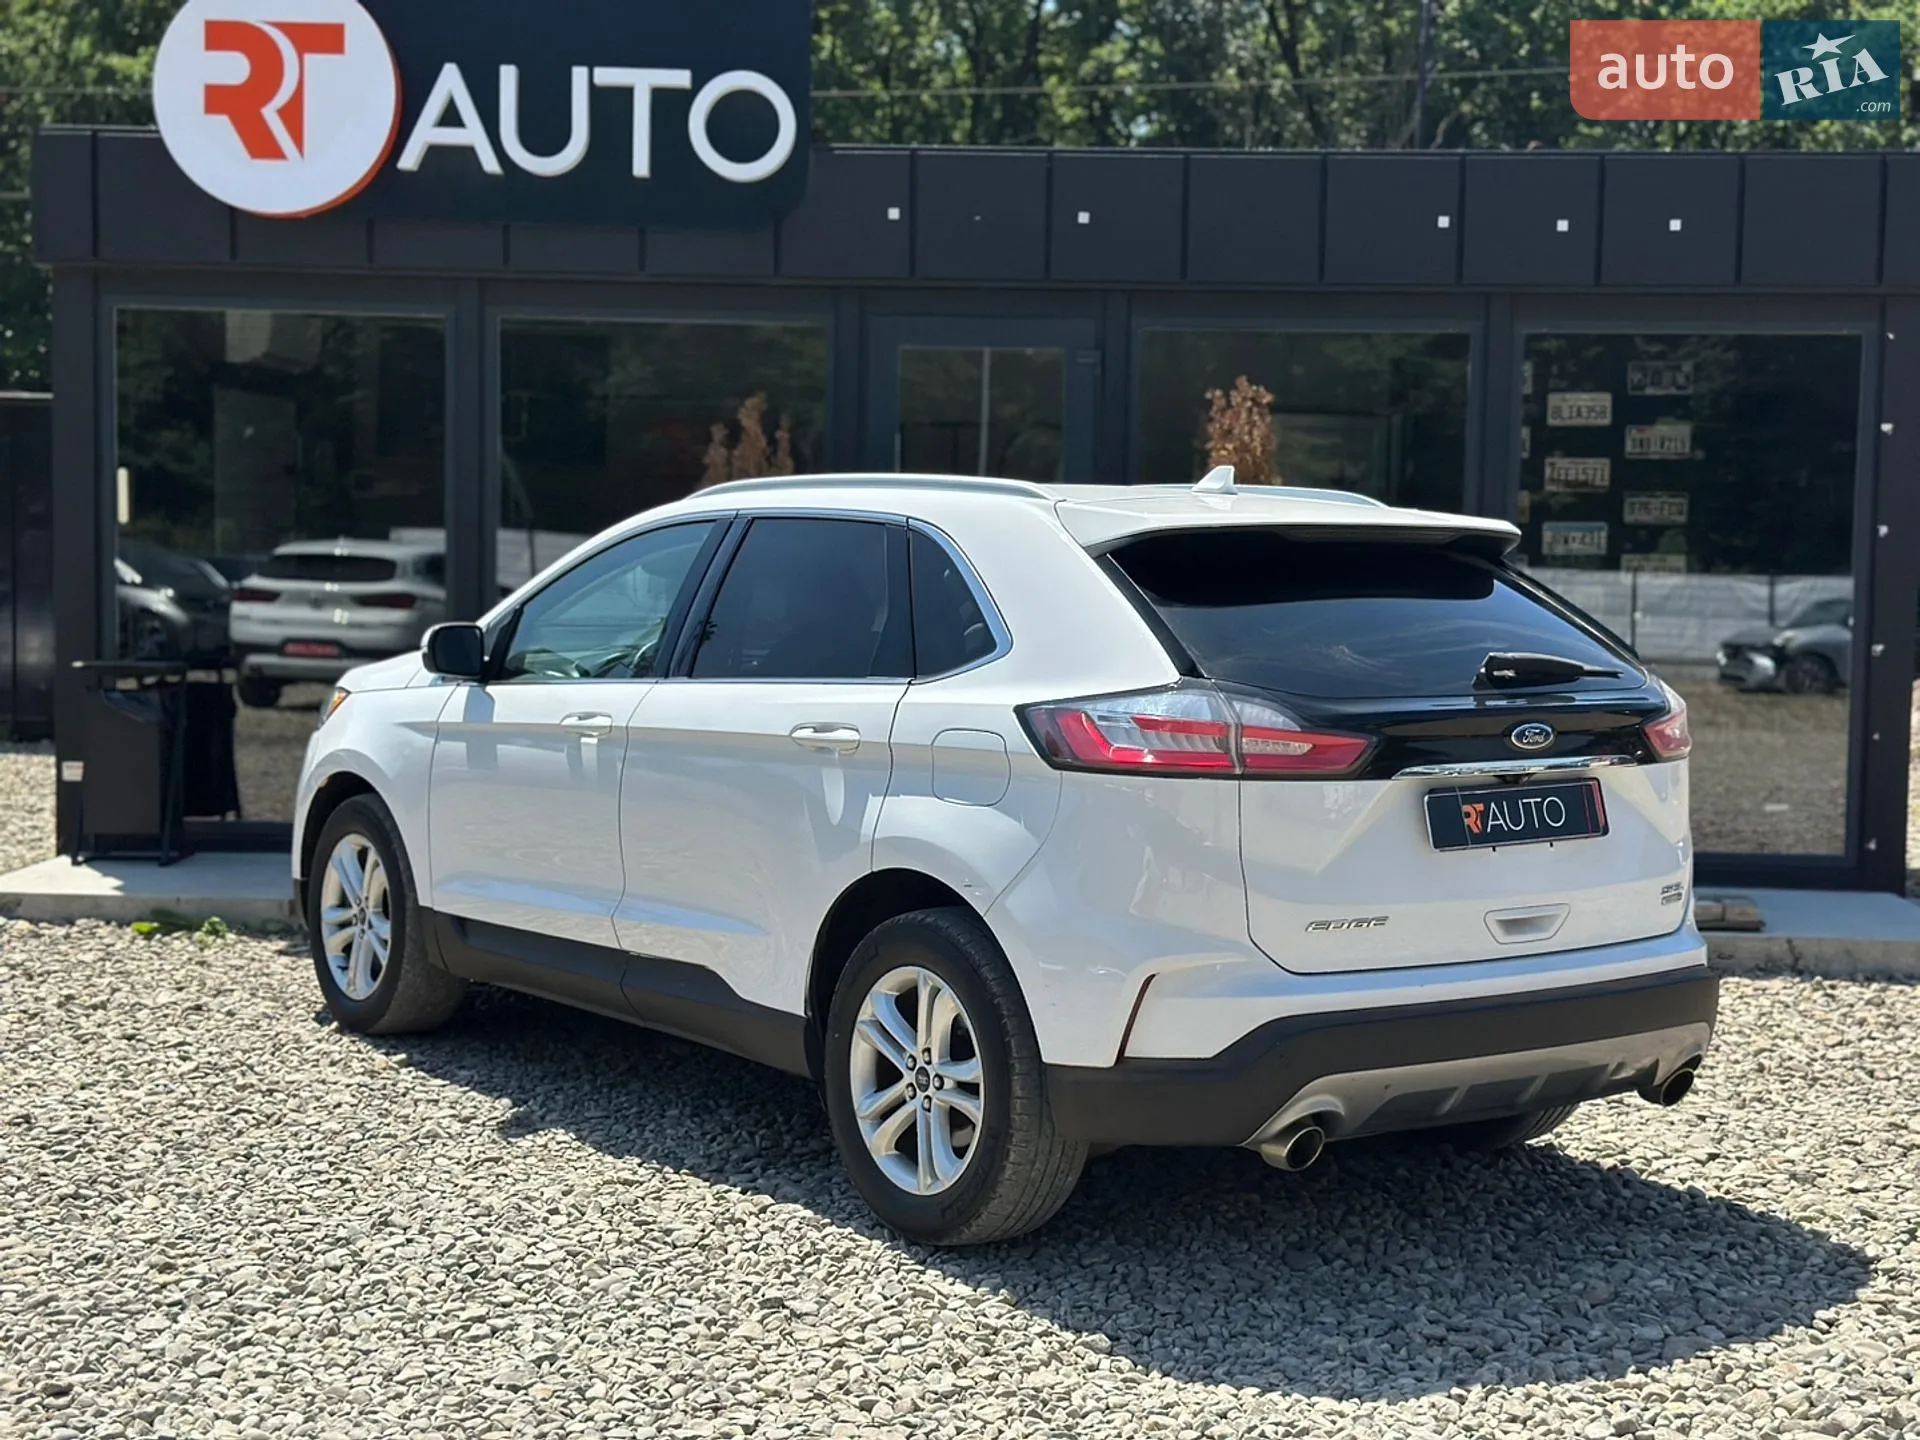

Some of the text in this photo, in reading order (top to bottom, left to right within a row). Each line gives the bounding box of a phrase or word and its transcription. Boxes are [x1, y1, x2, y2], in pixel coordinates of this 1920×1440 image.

[203, 19, 798, 184] RT AUTO
[1521, 728, 1546, 744] Ford
[1487, 796, 1566, 833] AUTO
[1304, 915, 1390, 933] EDGE
